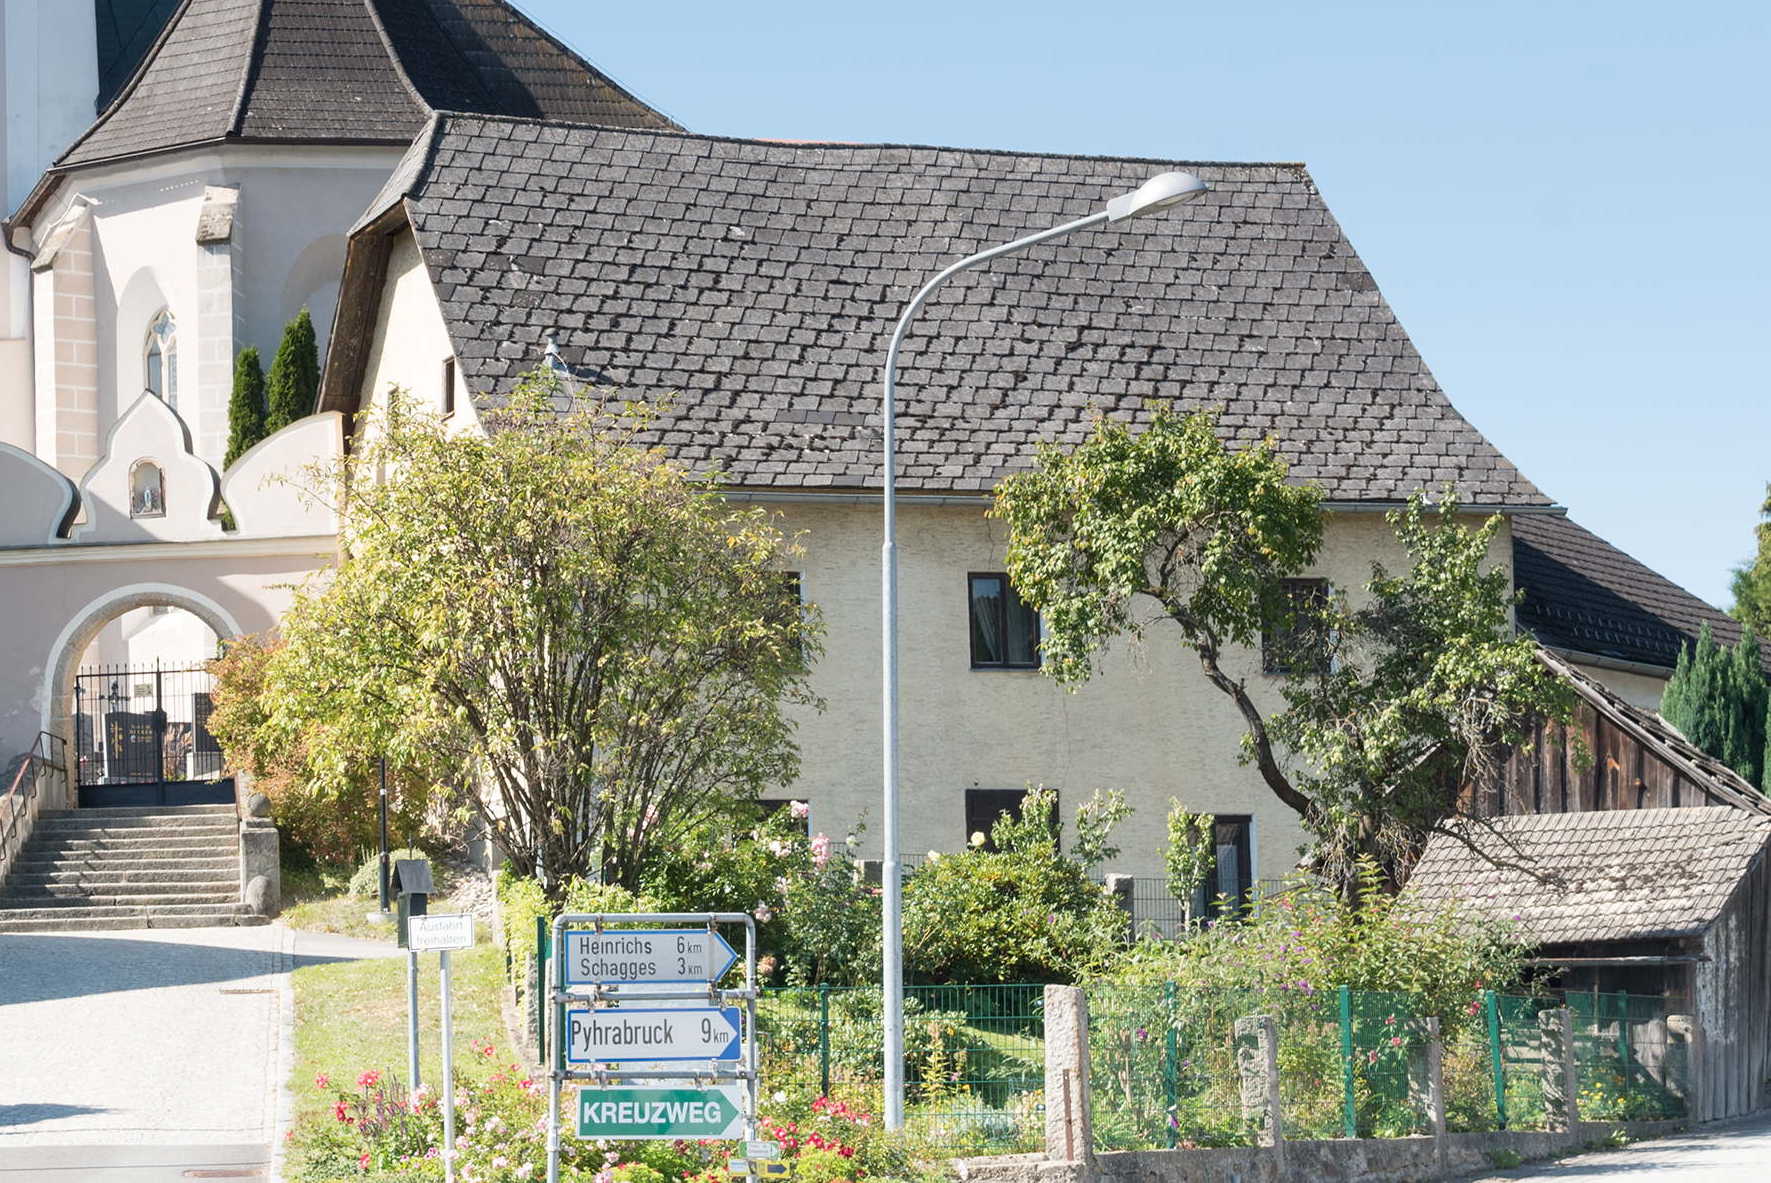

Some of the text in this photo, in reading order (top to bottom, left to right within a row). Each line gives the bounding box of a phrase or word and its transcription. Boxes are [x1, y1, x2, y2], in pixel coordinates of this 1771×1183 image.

[419, 921, 463, 932] Ausfahrt
[417, 934, 467, 946] freihalten
[579, 936, 702, 955] Heinrichs 6 km
[581, 957, 703, 980] Schagges 3 km
[571, 1017, 729, 1052] Pyhrabruck 9 km
[583, 1101, 721, 1125] KREUZWEG
